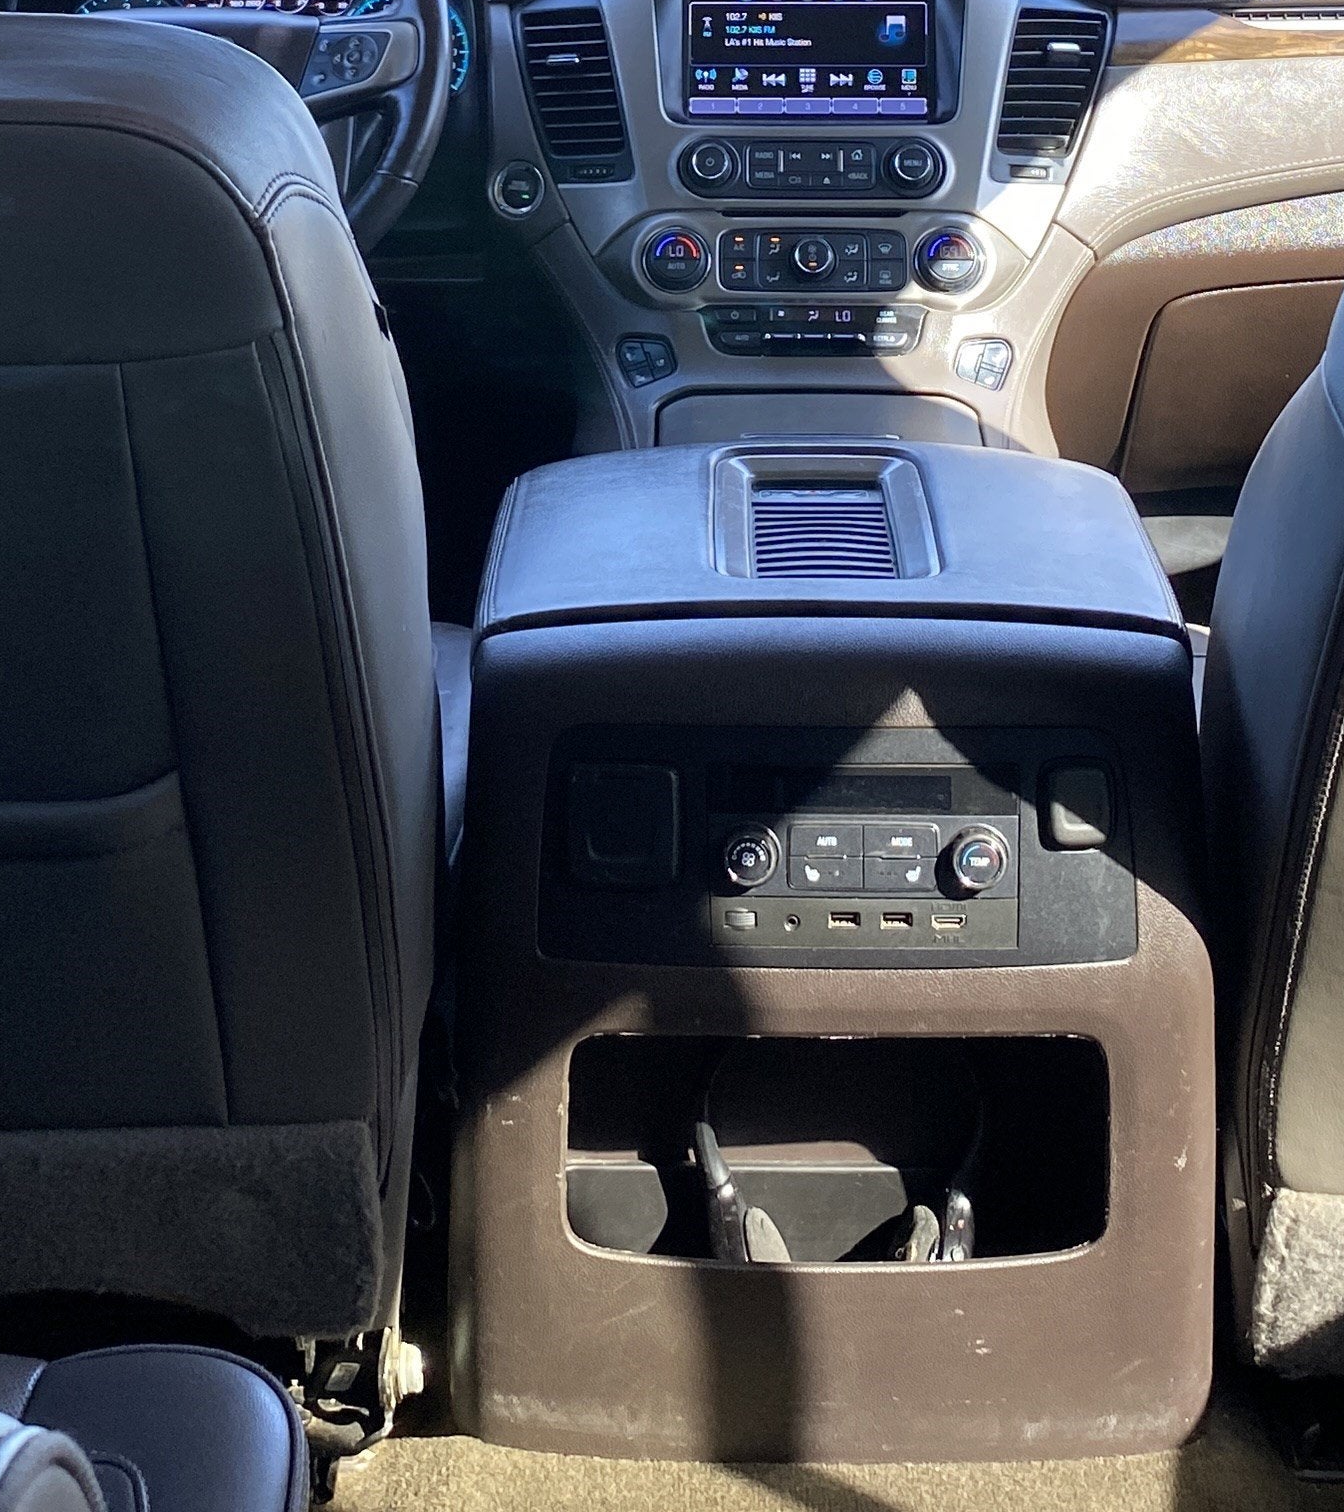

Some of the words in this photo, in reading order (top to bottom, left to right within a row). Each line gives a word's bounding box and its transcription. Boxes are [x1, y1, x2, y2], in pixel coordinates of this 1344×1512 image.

[725, 12, 748, 21] 102.7
[725, 25, 747, 34] 102.7
[753, 38, 764, 46] Hit
[765, 38, 786, 46] Music
[787, 38, 812, 46] Station
[754, 151, 774, 159] RADIO
[903, 159, 922, 167] MENU
[754, 171, 775, 179] MEDIA
[668, 245, 685, 258] LO
[667, 262, 686, 270] AUTO
[816, 836, 838, 847] AUTO
[891, 836, 913, 847] MODE
[968, 856, 991, 867] TEMP
